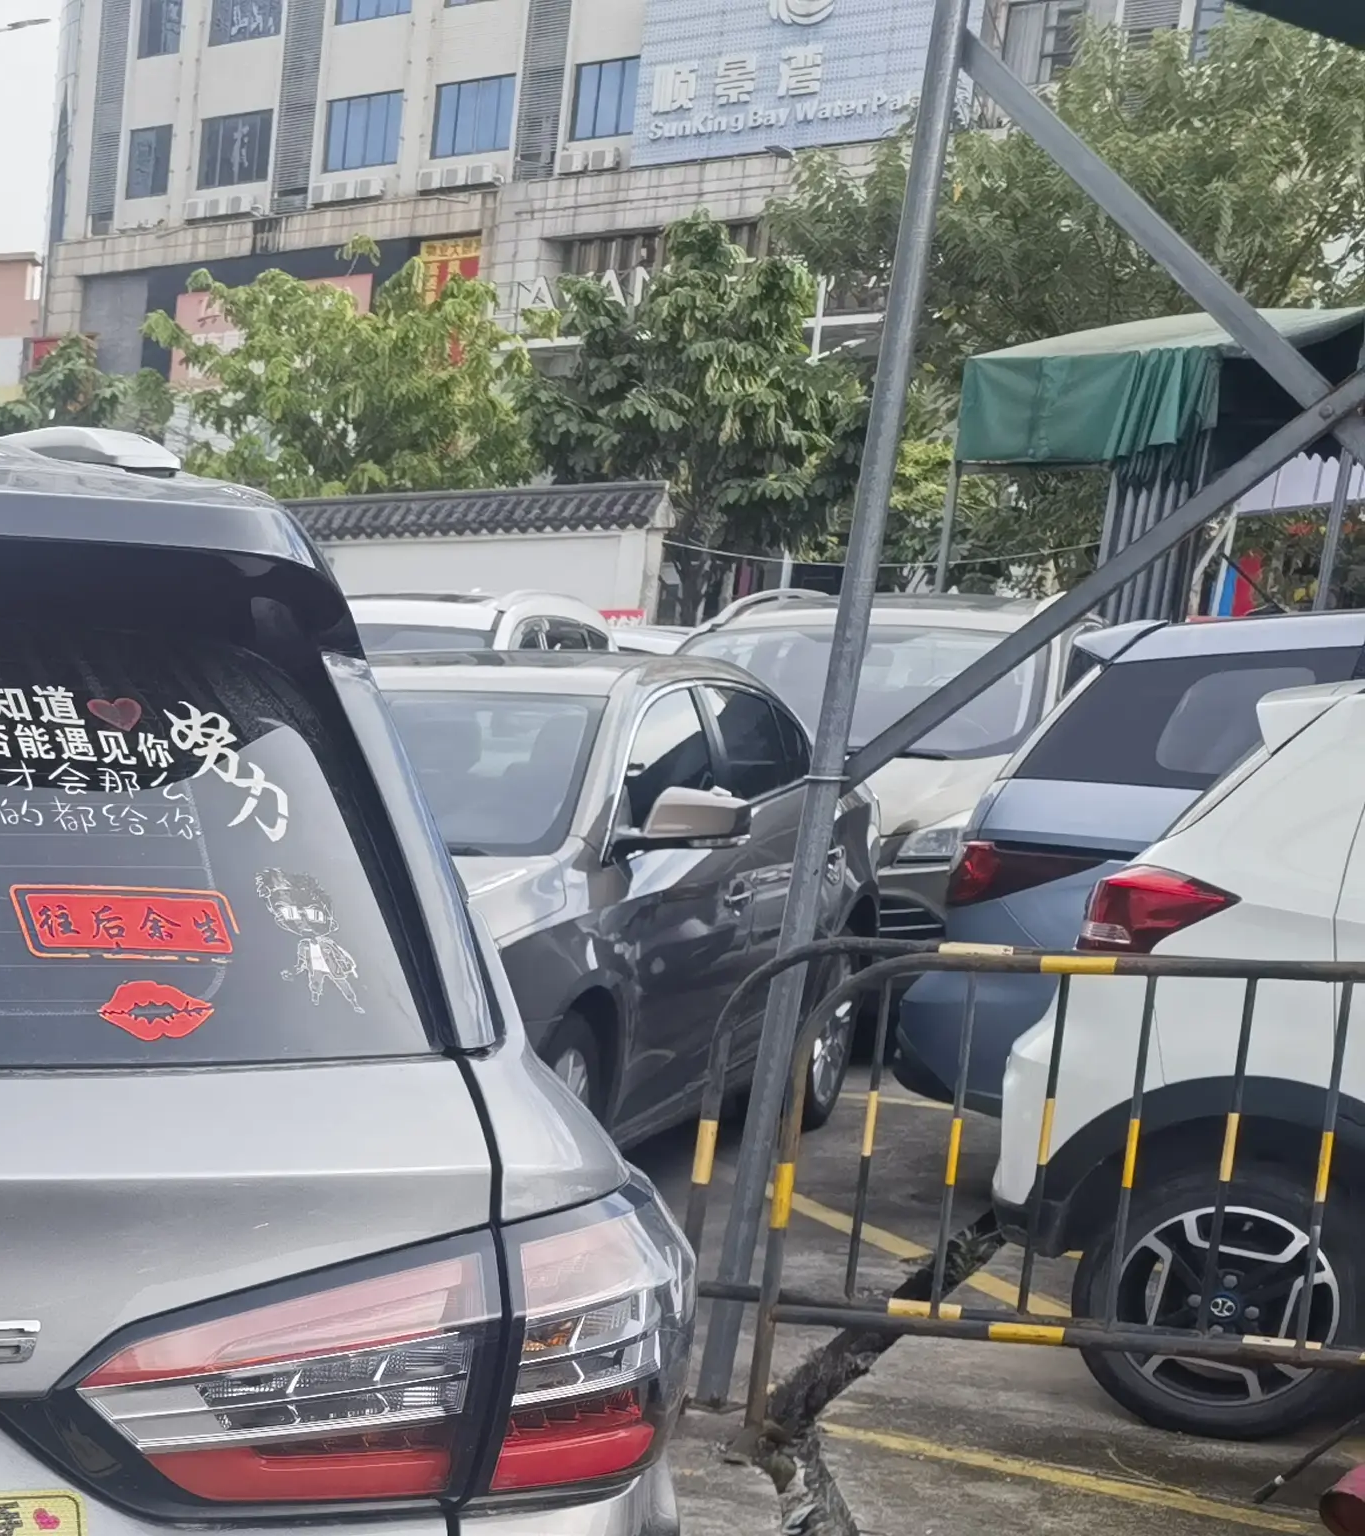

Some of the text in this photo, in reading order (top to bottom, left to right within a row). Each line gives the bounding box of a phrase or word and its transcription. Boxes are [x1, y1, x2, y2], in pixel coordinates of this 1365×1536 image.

[650, 44, 822, 114] 顺景湾
[751, 105, 792, 130] Bay
[795, 97, 867, 122] Water
[163, 701, 289, 842] 努力
[37, 904, 227, 944] 往后余生
